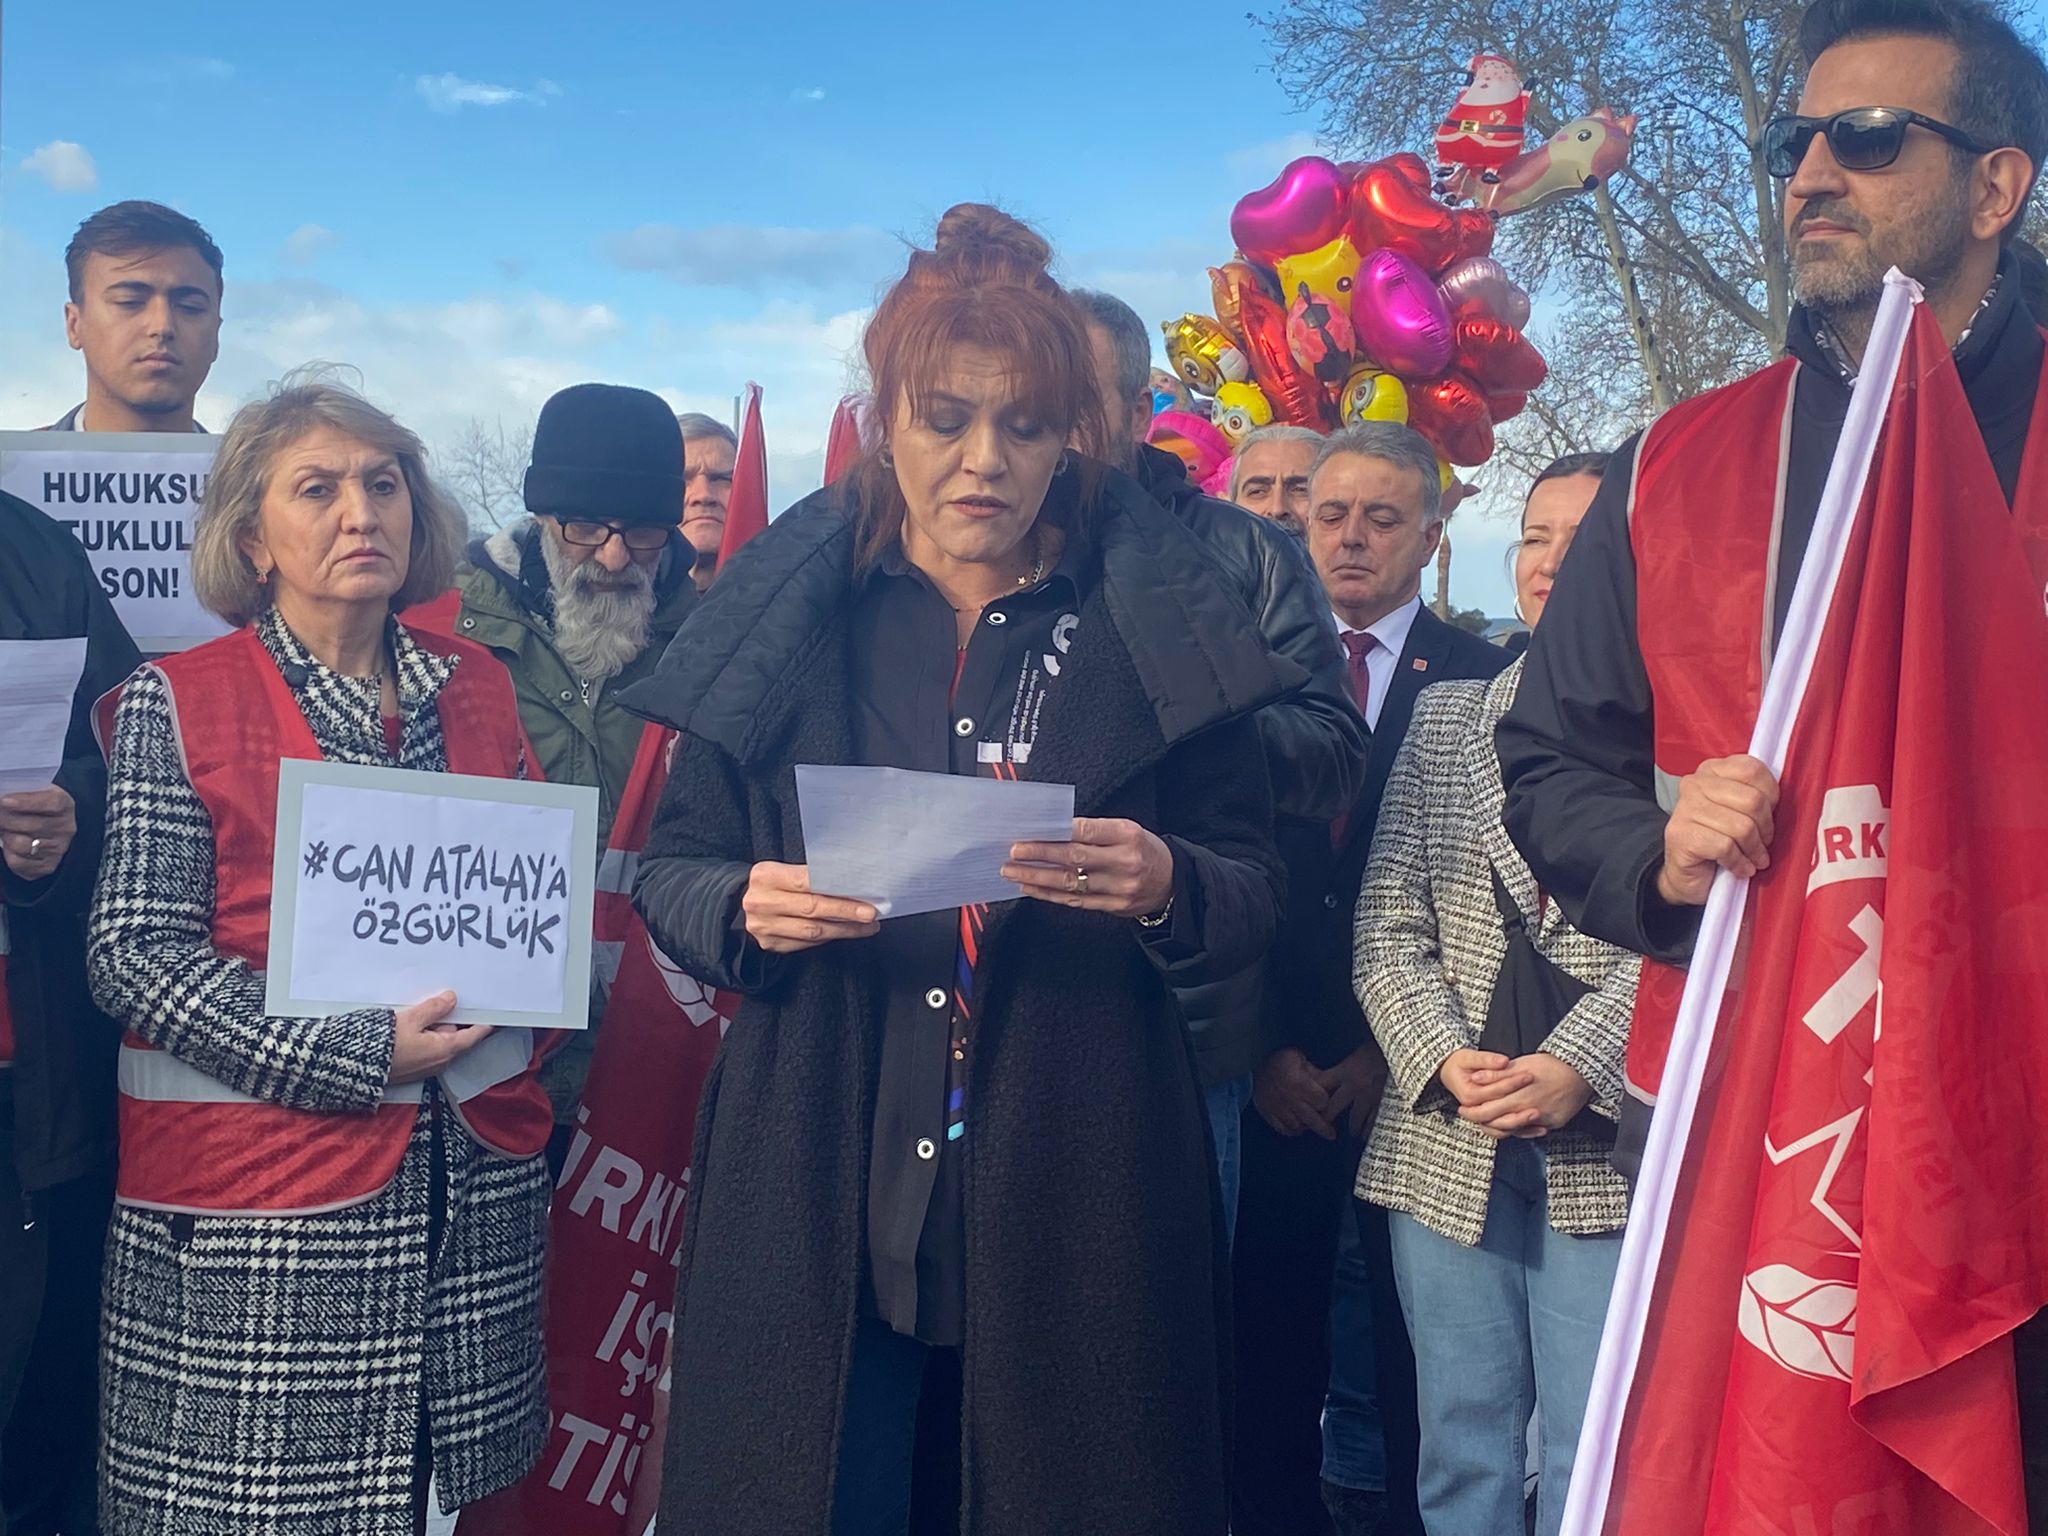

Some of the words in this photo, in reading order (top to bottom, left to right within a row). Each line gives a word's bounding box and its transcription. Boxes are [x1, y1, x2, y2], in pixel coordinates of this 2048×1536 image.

[58, 520, 200, 551] TUKLUL
[101, 567, 179, 599] SON!
[304, 840, 414, 894] #CAN
[423, 844, 568, 904] ATALAY'A
[1811, 822, 1887, 872] RK
[353, 898, 562, 959] ÖZGÜRLÜK
